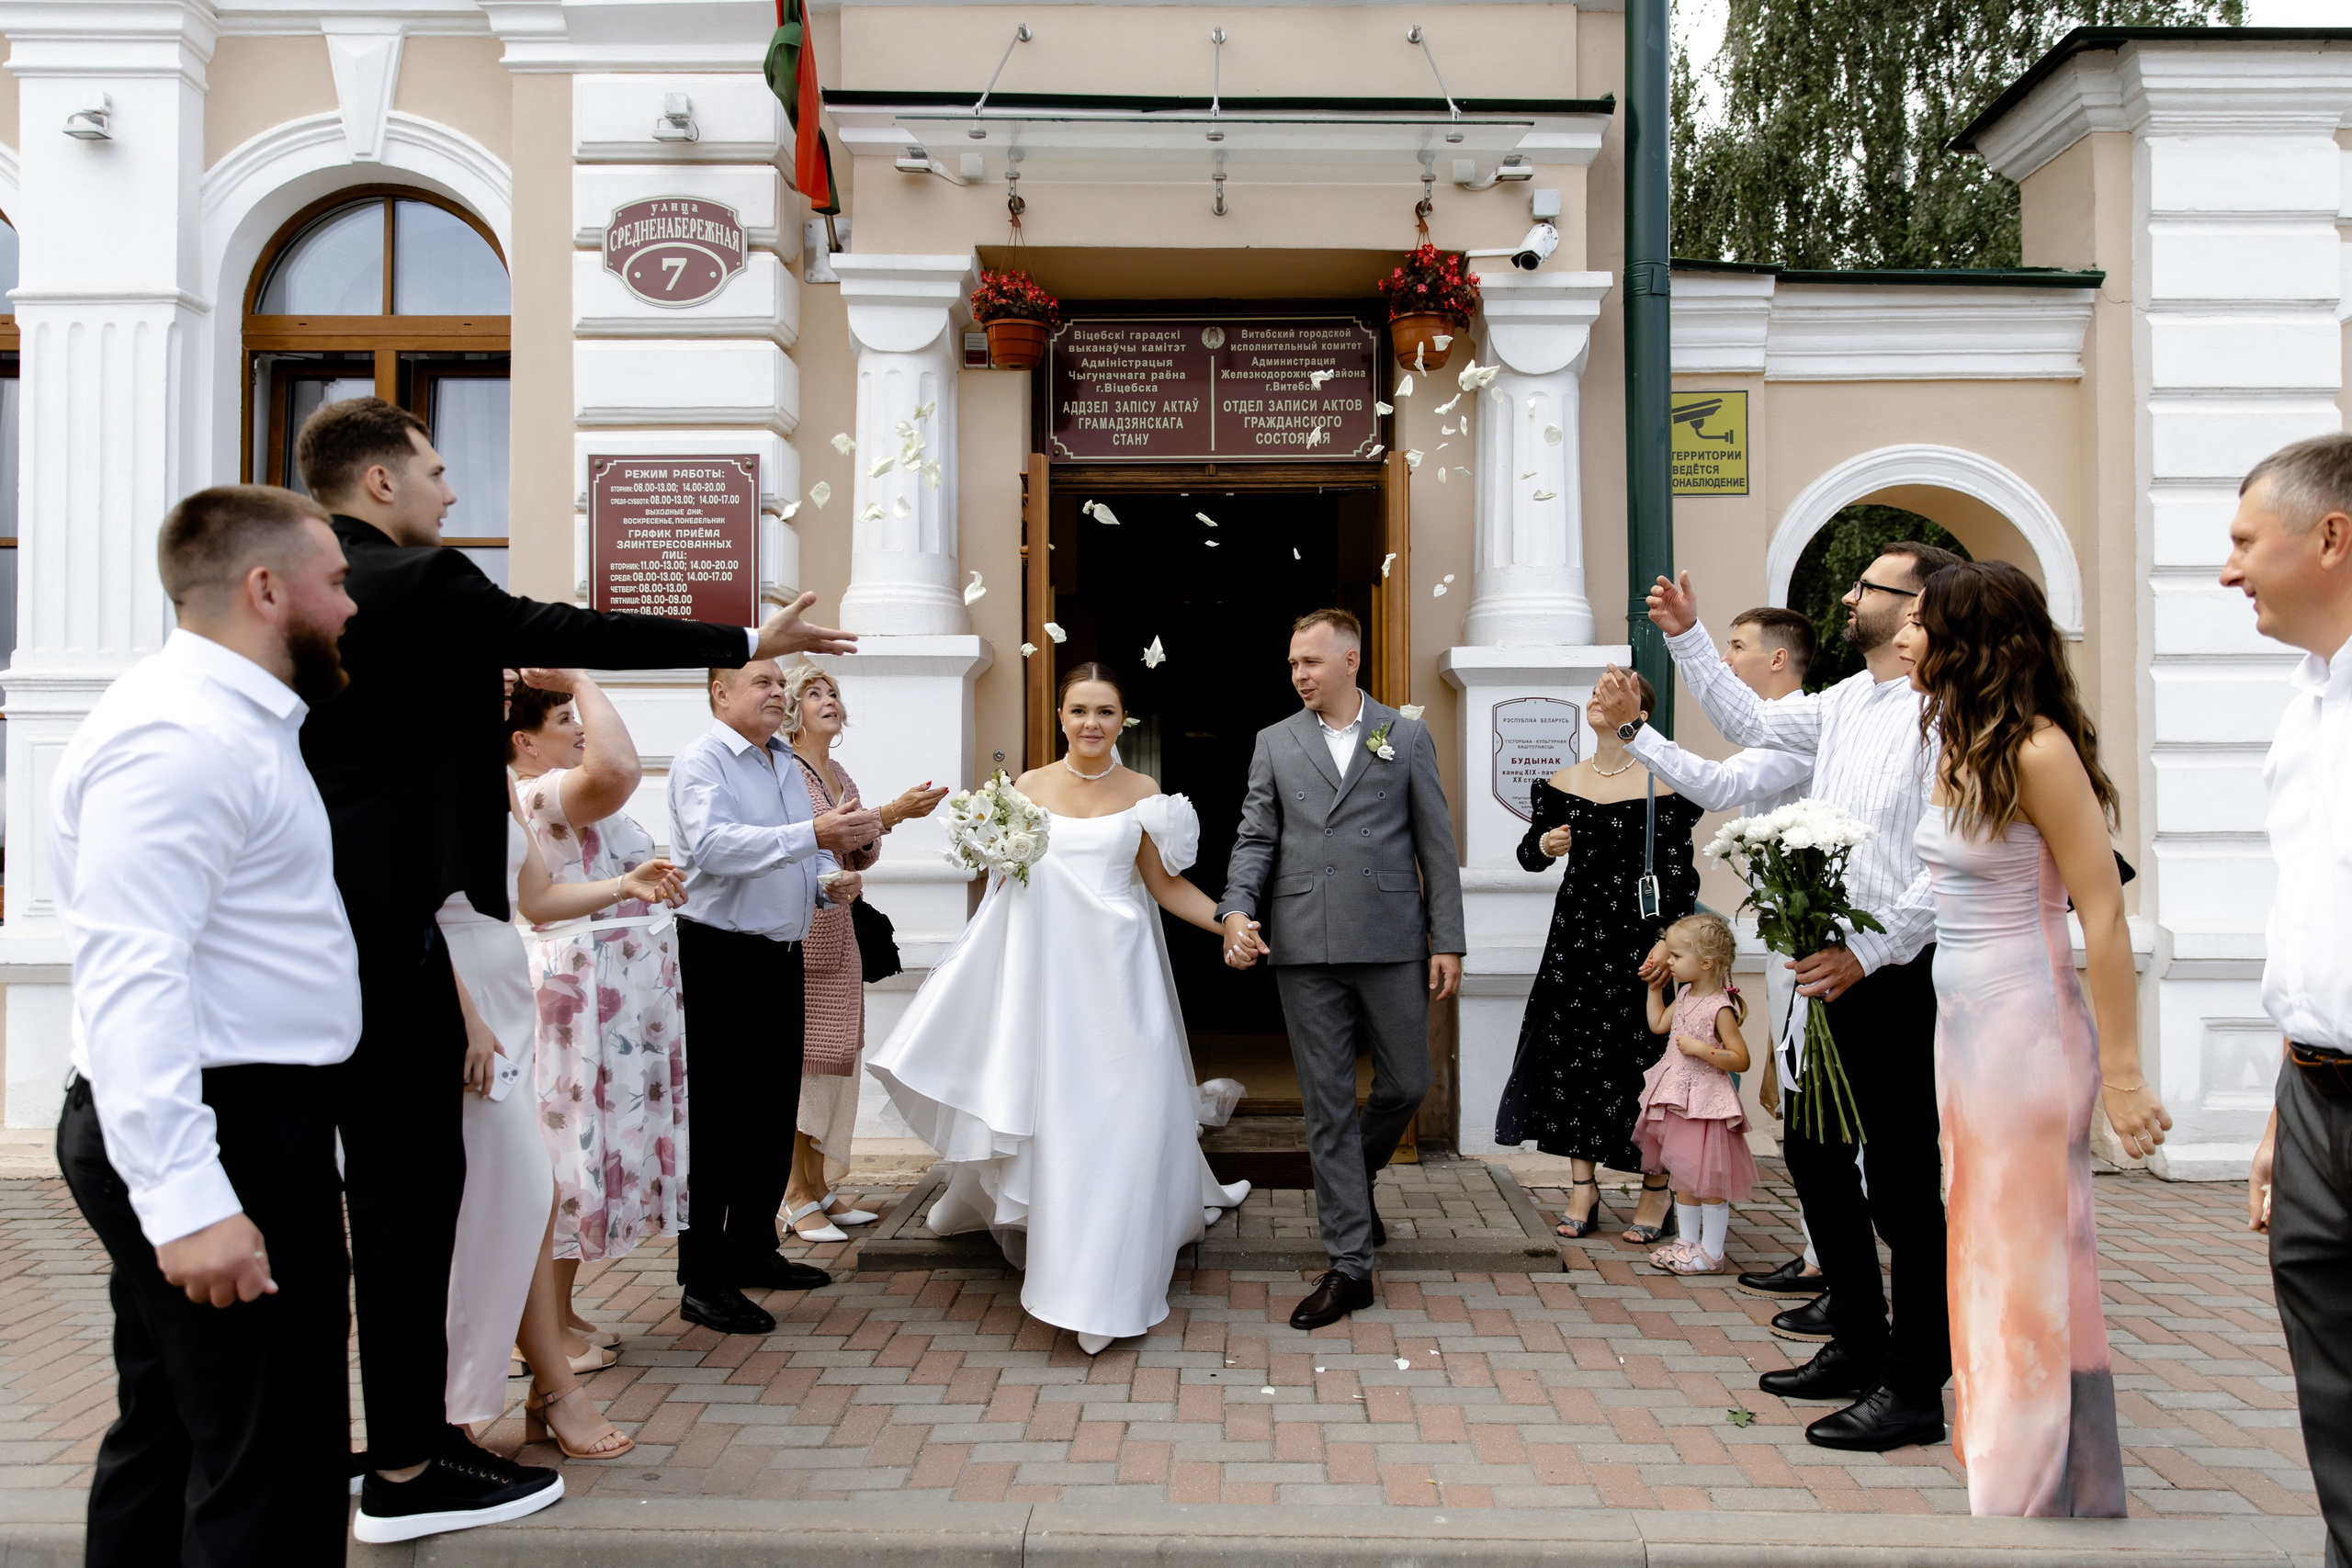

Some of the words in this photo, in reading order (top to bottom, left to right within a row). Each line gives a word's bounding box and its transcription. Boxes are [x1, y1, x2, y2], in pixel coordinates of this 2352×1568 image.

[651, 202, 698, 216] улица
[610, 217, 740, 253] СРЕДНЕНАБЕРЕЖНАЯ
[662, 257, 687, 291] 7
[1074, 331, 1125, 341] Віцебскі
[1130, 331, 1181, 341] гарадскі
[1242, 329, 1295, 339] Витебский
[1299, 329, 1351, 340] городской
[1069, 344, 1136, 355] выканаўчы
[1142, 343, 1186, 352] камітэт
[1231, 342, 1317, 352] исполнительный
[1322, 342, 1362, 350] комитет
[1081, 358, 1173, 369] Адміністрацыя
[1252, 357, 1336, 367] Администрация
[1069, 371, 1146, 381] Чыгуначнага
[1151, 371, 1186, 381] раёна
[1221, 369, 1313, 380] Железнодорожно
[1096, 383, 1158, 393] г.Віцебска
[1063, 400, 1108, 415] АДДЗЕЛ
[1115, 400, 1157, 413] ЗАПІСУ
[1163, 398, 1199, 412] АКТАЎ
[1224, 400, 1263, 414] ОТДЕЛ
[1268, 400, 1317, 412] ЗАПИСИ
[1323, 400, 1363, 412] АКТОВ
[1079, 417, 1184, 431] ГРАМАДЗЯНСКАГА
[1244, 416, 1342, 430] ГРАЖДАНСКОГО
[1113, 434, 1149, 446] СТАНУ
[626, 469, 668, 479] РЕЖИМ
[673, 469, 725, 479] РАБОТЫ:
[1673, 463, 1719, 476] ВЕДЁТСЯ
[684, 483, 726, 491] 14.00-20.00
[1672, 478, 1745, 489] ОНАБЛЮДЕНИЕ
[700, 494, 740, 504] 14.00-17.00
[628, 529, 672, 538] ГРАФИК
[676, 527, 720, 538] ПРИЁМА
[616, 540, 732, 549] ЗАИНТЕРЕСОВАННЫХ
[662, 551, 687, 559] ЛИЦ:
[691, 560, 739, 570] 14.00-20.00
[687, 572, 732, 581] 14.00-17.00
[639, 583, 688, 592] 08.00-13.00
[641, 595, 693, 604] 08.00-09.00
